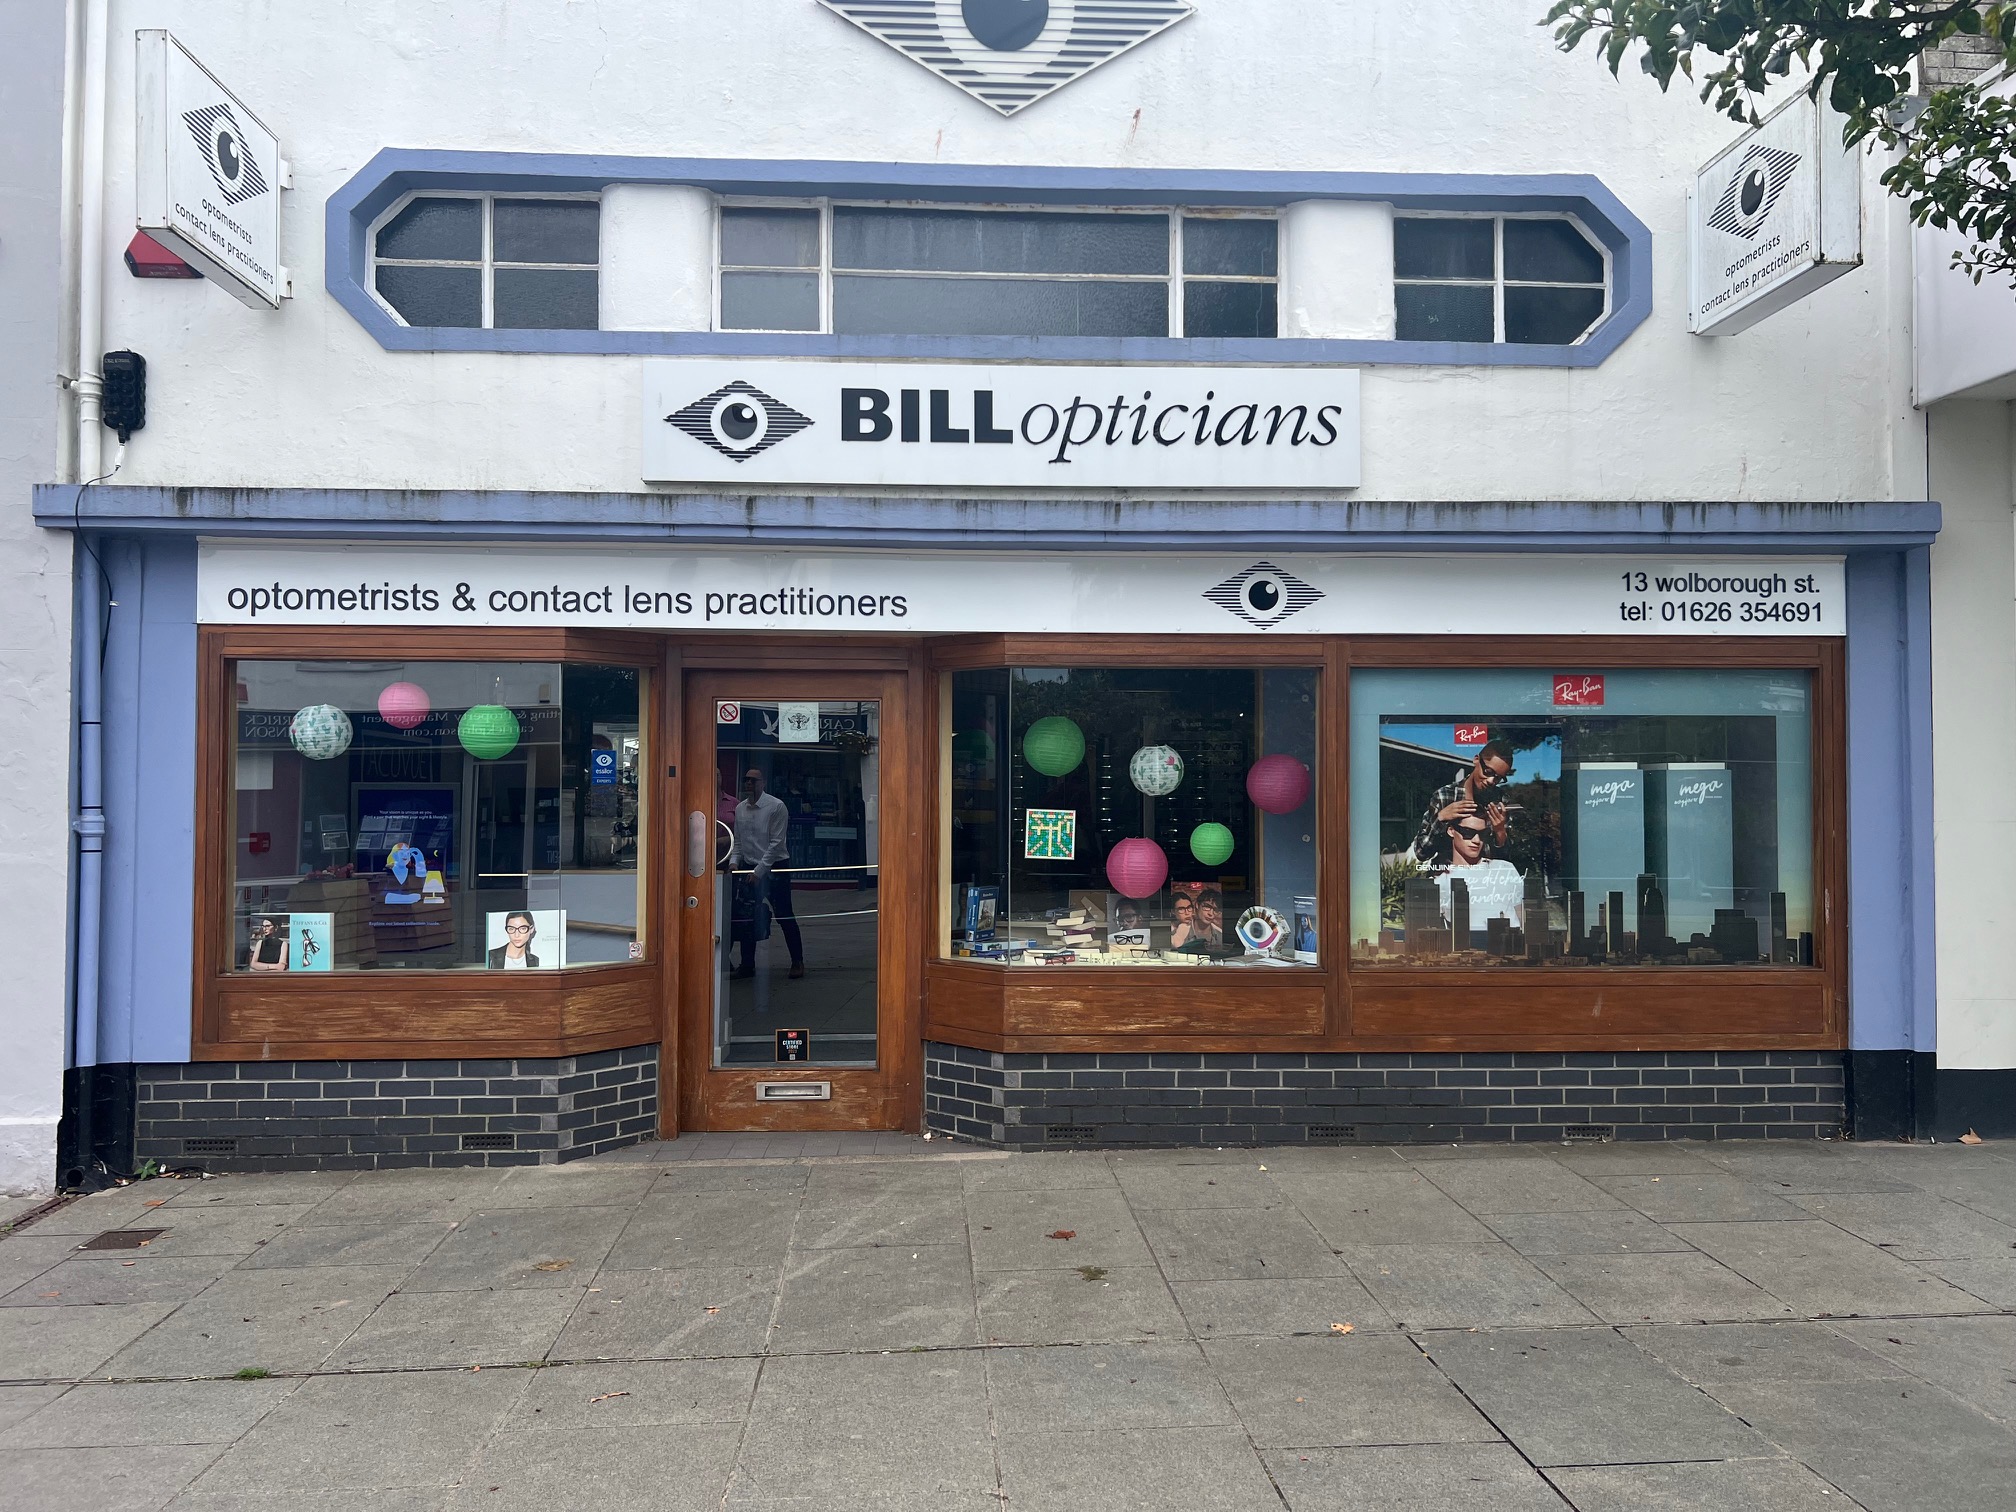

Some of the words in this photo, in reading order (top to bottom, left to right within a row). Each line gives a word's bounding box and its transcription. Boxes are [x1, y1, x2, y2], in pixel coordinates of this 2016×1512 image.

[201, 198, 252, 244] optometrists
[175, 203, 207, 235] contact
[209, 224, 225, 247] lens
[227, 241, 274, 285] practitioners
[1725, 234, 1781, 278] optometrists
[1701, 290, 1731, 314] contact
[1732, 278, 1749, 295] lens
[1752, 240, 1810, 287] practitioners
[841, 387, 1013, 443] BILL
[1021, 390, 1341, 463] opticians
[227, 581, 440, 617] optometrists
[451, 582, 476, 612] &
[488, 584, 613, 614] contact
[624, 585, 693, 614] lens
[705, 586, 908, 621] practitioners
[1621, 571, 1648, 592] 13
[1655, 572, 1787, 598] wolborough
[1794, 574, 1821, 593] st.
[1620, 601, 1653, 621] tel:
[1661, 601, 1732, 622] 01626
[1739, 602, 1822, 622] 354691
[1555, 676, 1602, 702] Ray-Ban
[1455, 725, 1486, 742] Ray-Ban
[367, 744, 428, 780] ACUVUE
[1590, 779, 1635, 804] mega
[1679, 779, 1723, 804] mega
